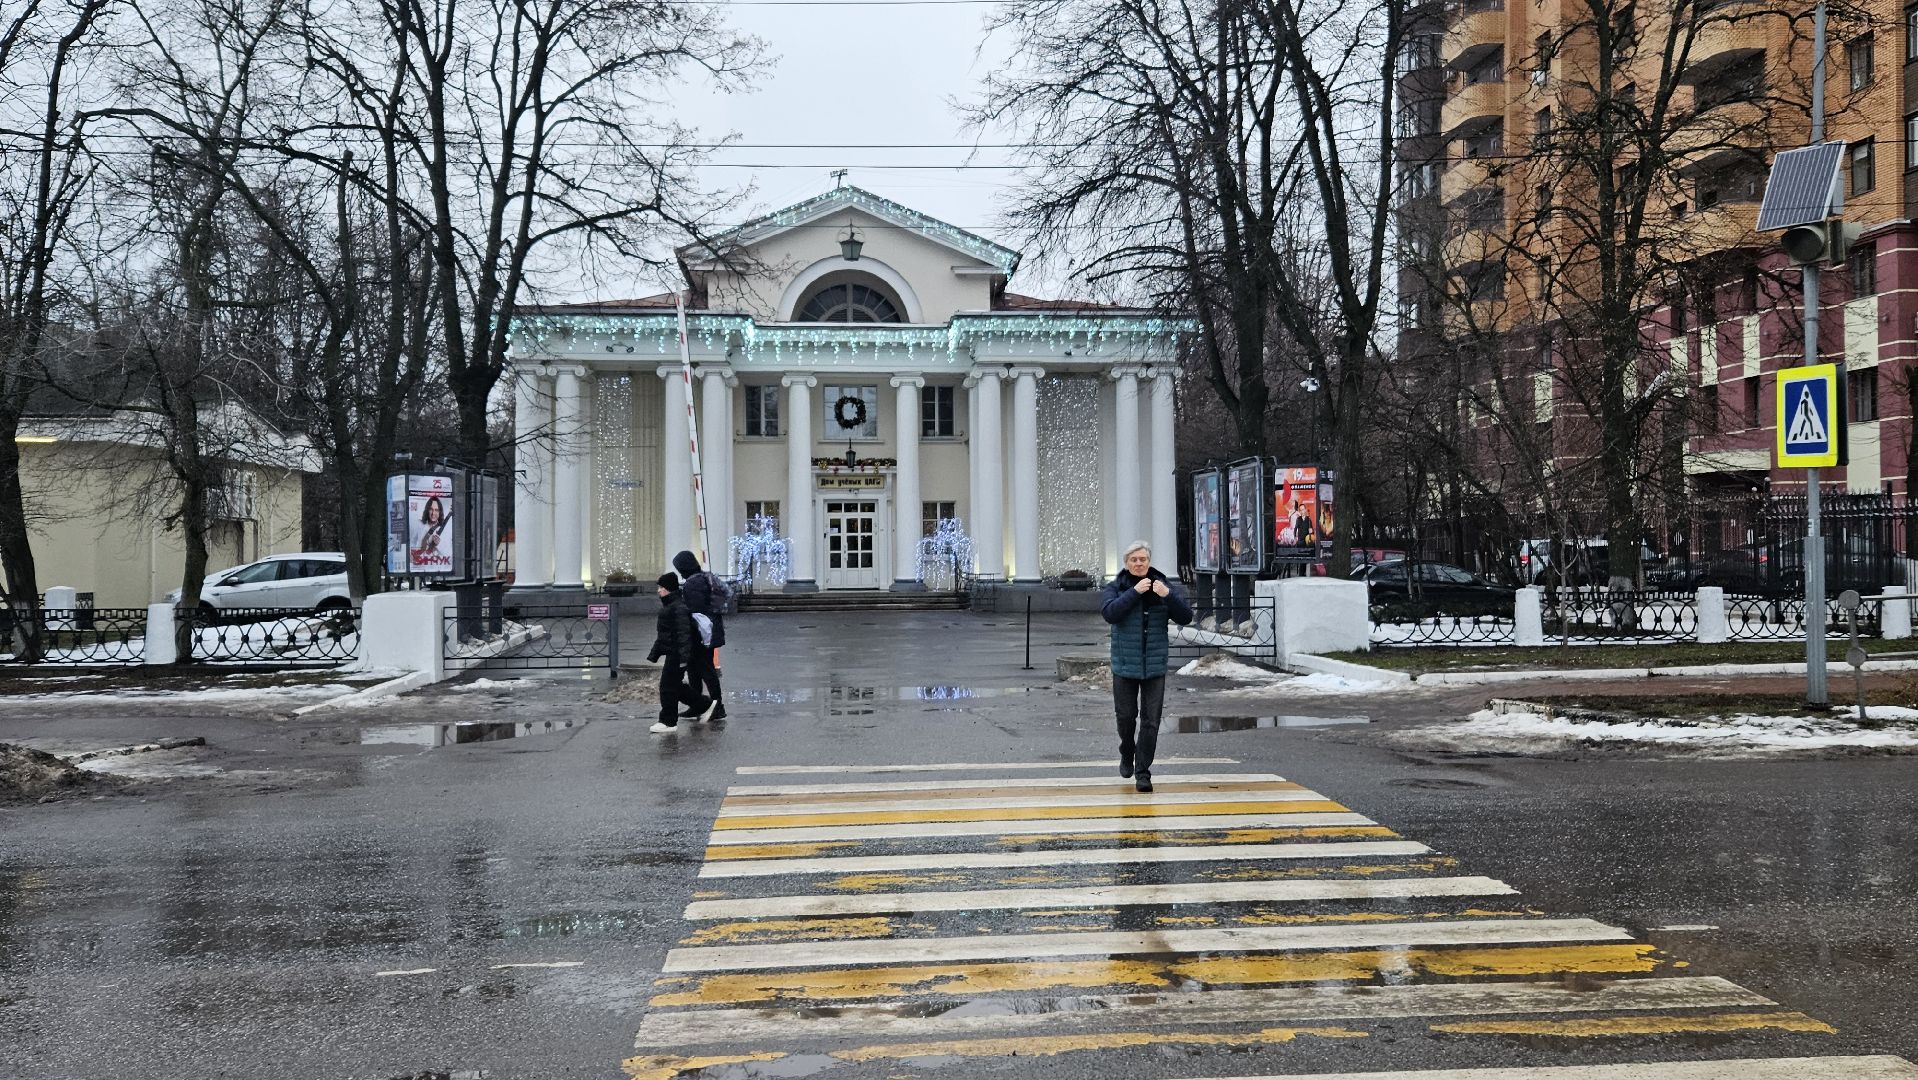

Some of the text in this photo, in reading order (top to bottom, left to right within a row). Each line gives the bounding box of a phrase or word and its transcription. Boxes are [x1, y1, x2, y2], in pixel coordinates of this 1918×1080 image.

[1293, 468, 1303, 480] 19
[821, 478, 834, 486] Дом
[838, 478, 861, 486] учёных
